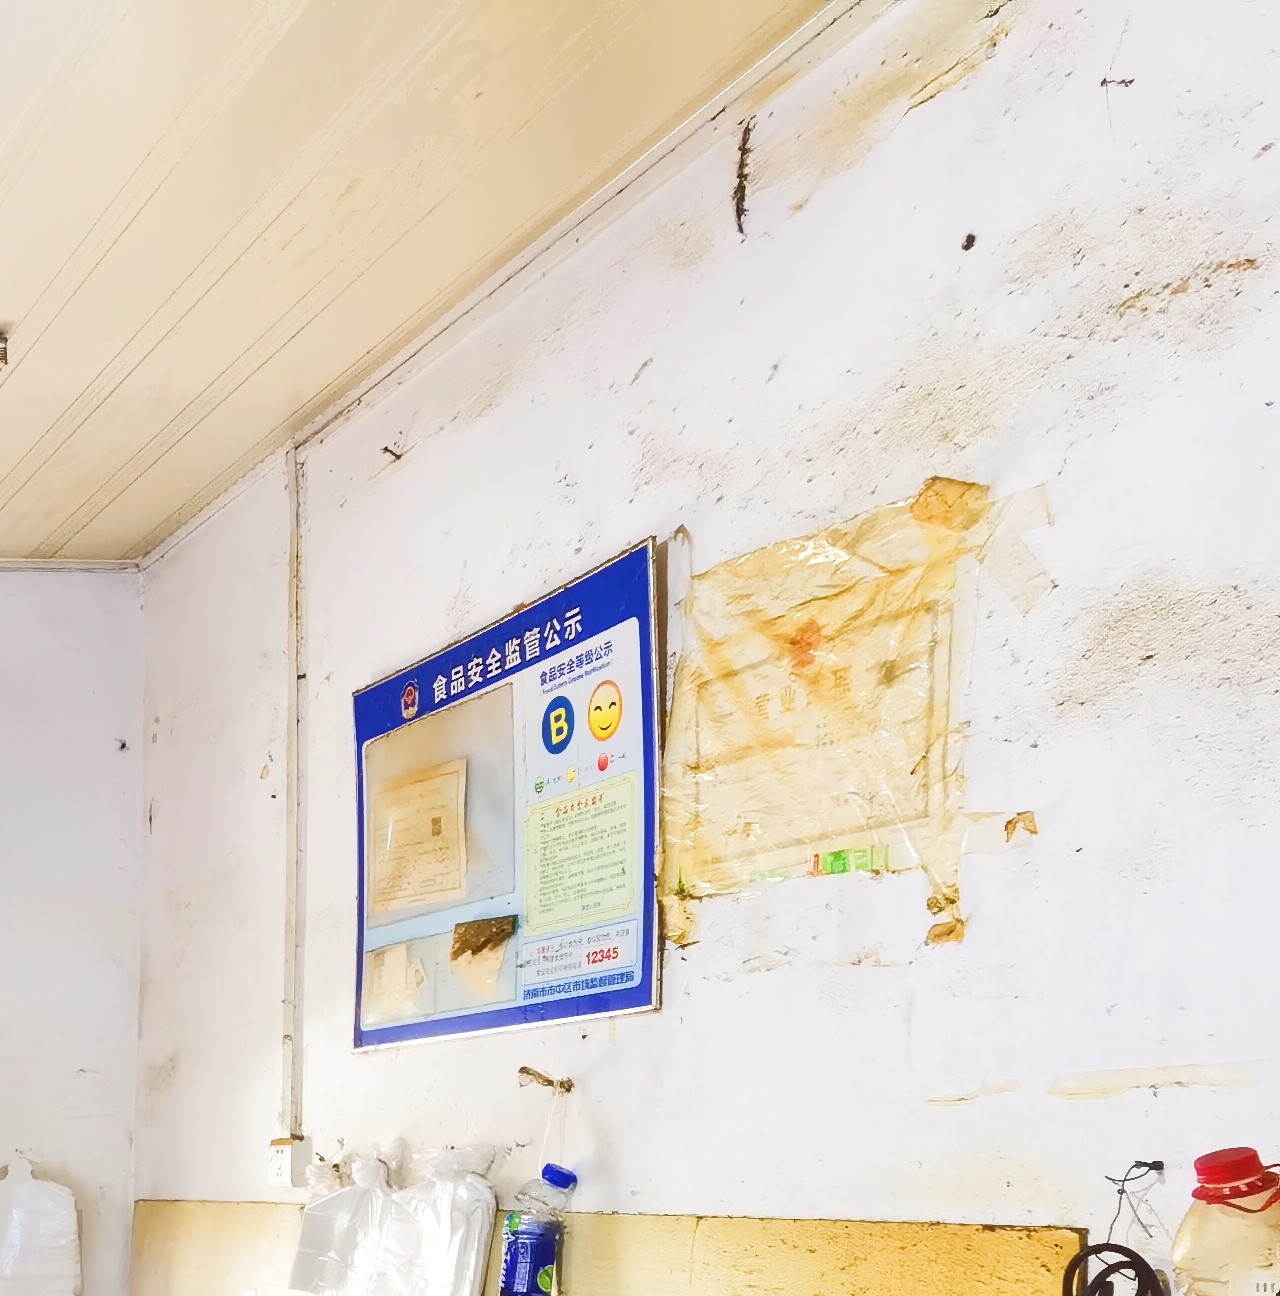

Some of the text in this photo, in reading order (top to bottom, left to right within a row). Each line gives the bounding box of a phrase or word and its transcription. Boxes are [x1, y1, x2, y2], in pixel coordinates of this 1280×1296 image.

[432, 606, 583, 704] 食品安全监管公示
[539, 640, 614, 687] 食品安全等级公示
[549, 706, 568, 746] B
[585, 946, 619, 965] 12345
